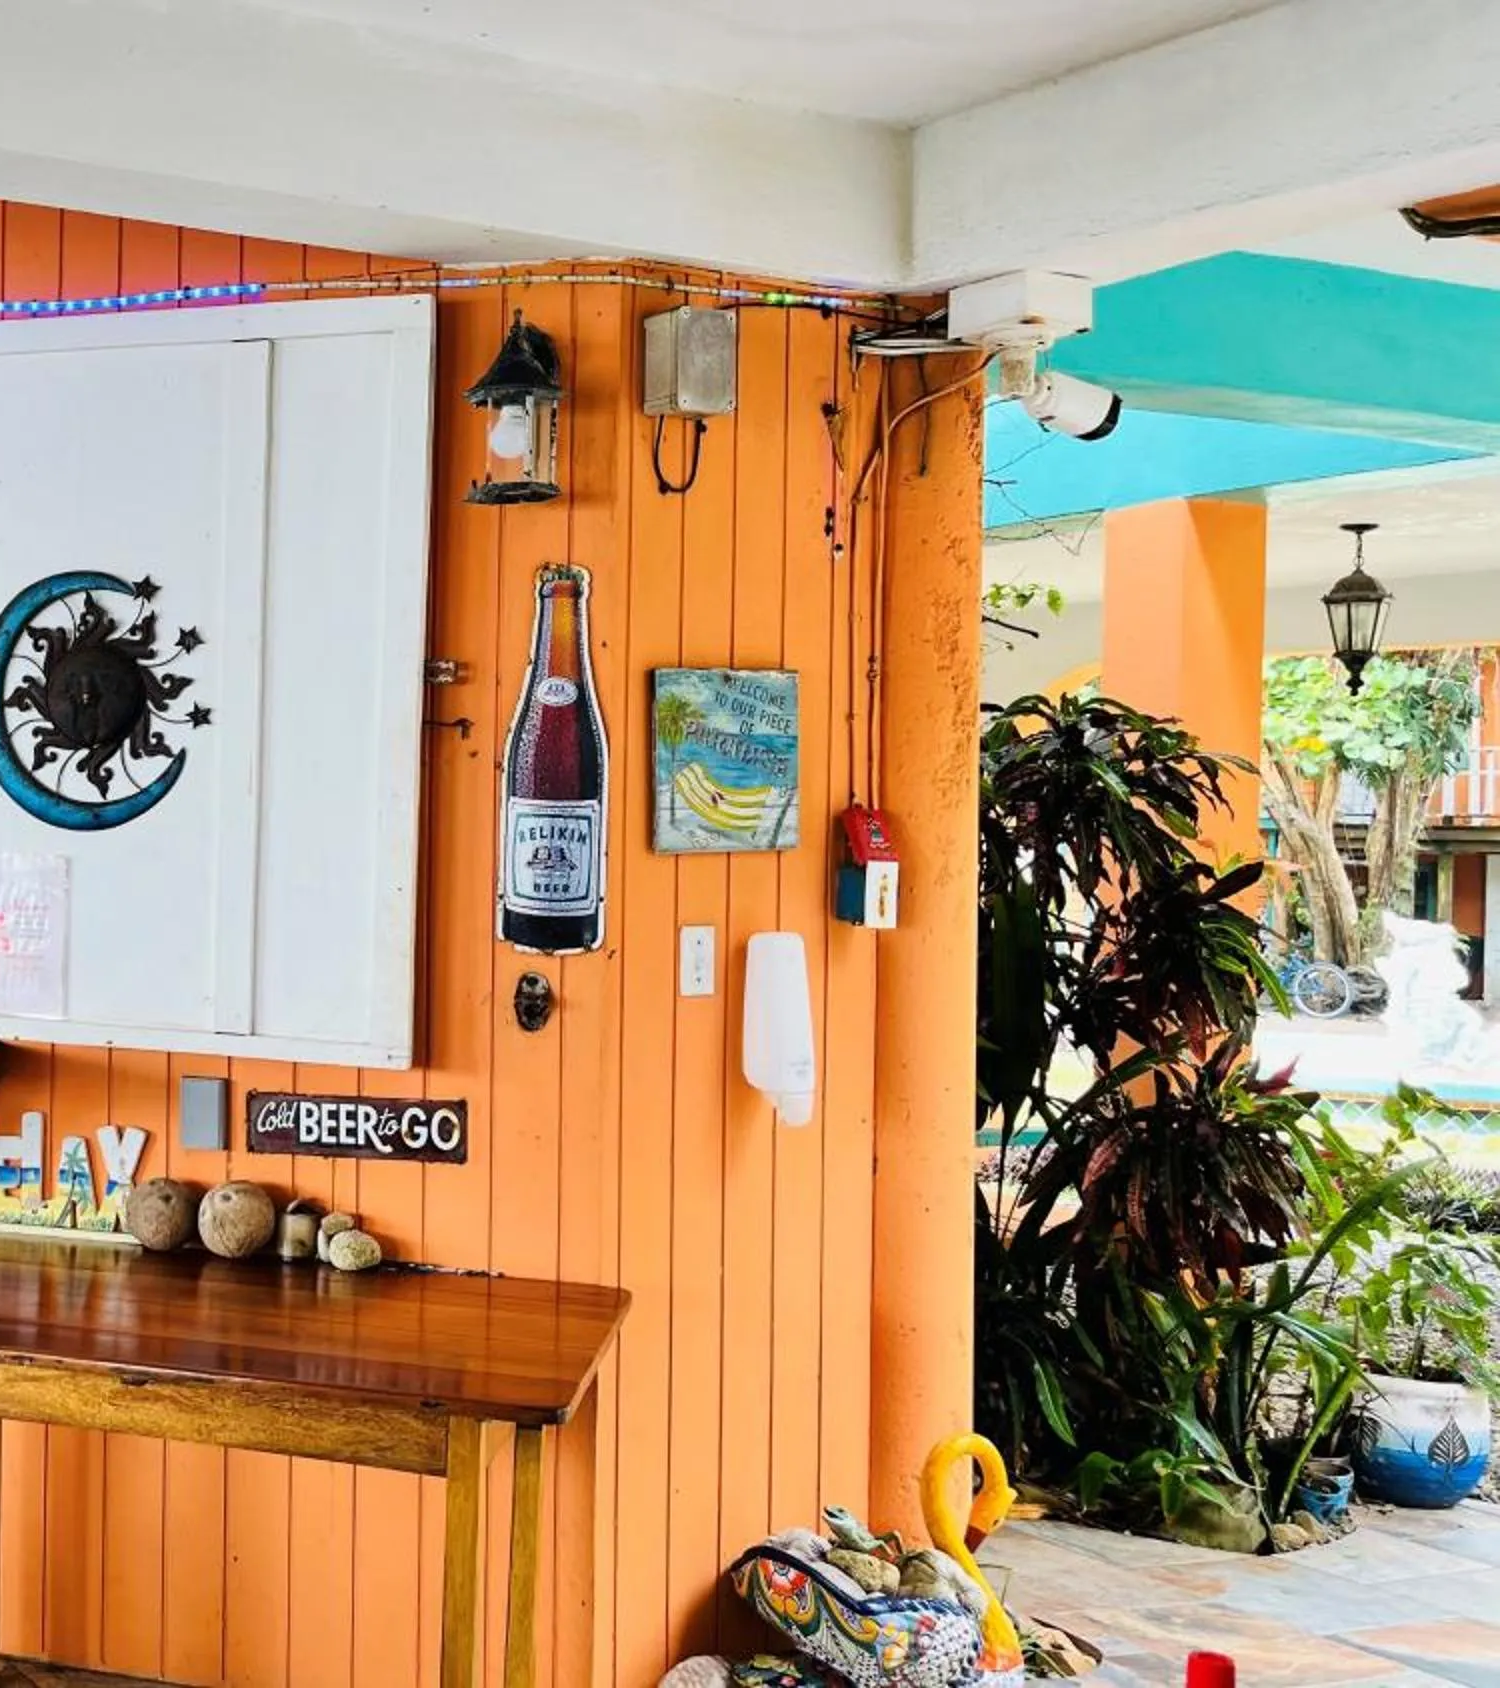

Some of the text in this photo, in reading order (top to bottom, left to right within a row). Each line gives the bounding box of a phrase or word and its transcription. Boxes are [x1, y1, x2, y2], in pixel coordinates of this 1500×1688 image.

[714, 691, 792, 735] TO OUR PIECE
[739, 719, 755, 736] OF
[256, 1101, 461, 1154] Cold BEER to GO
